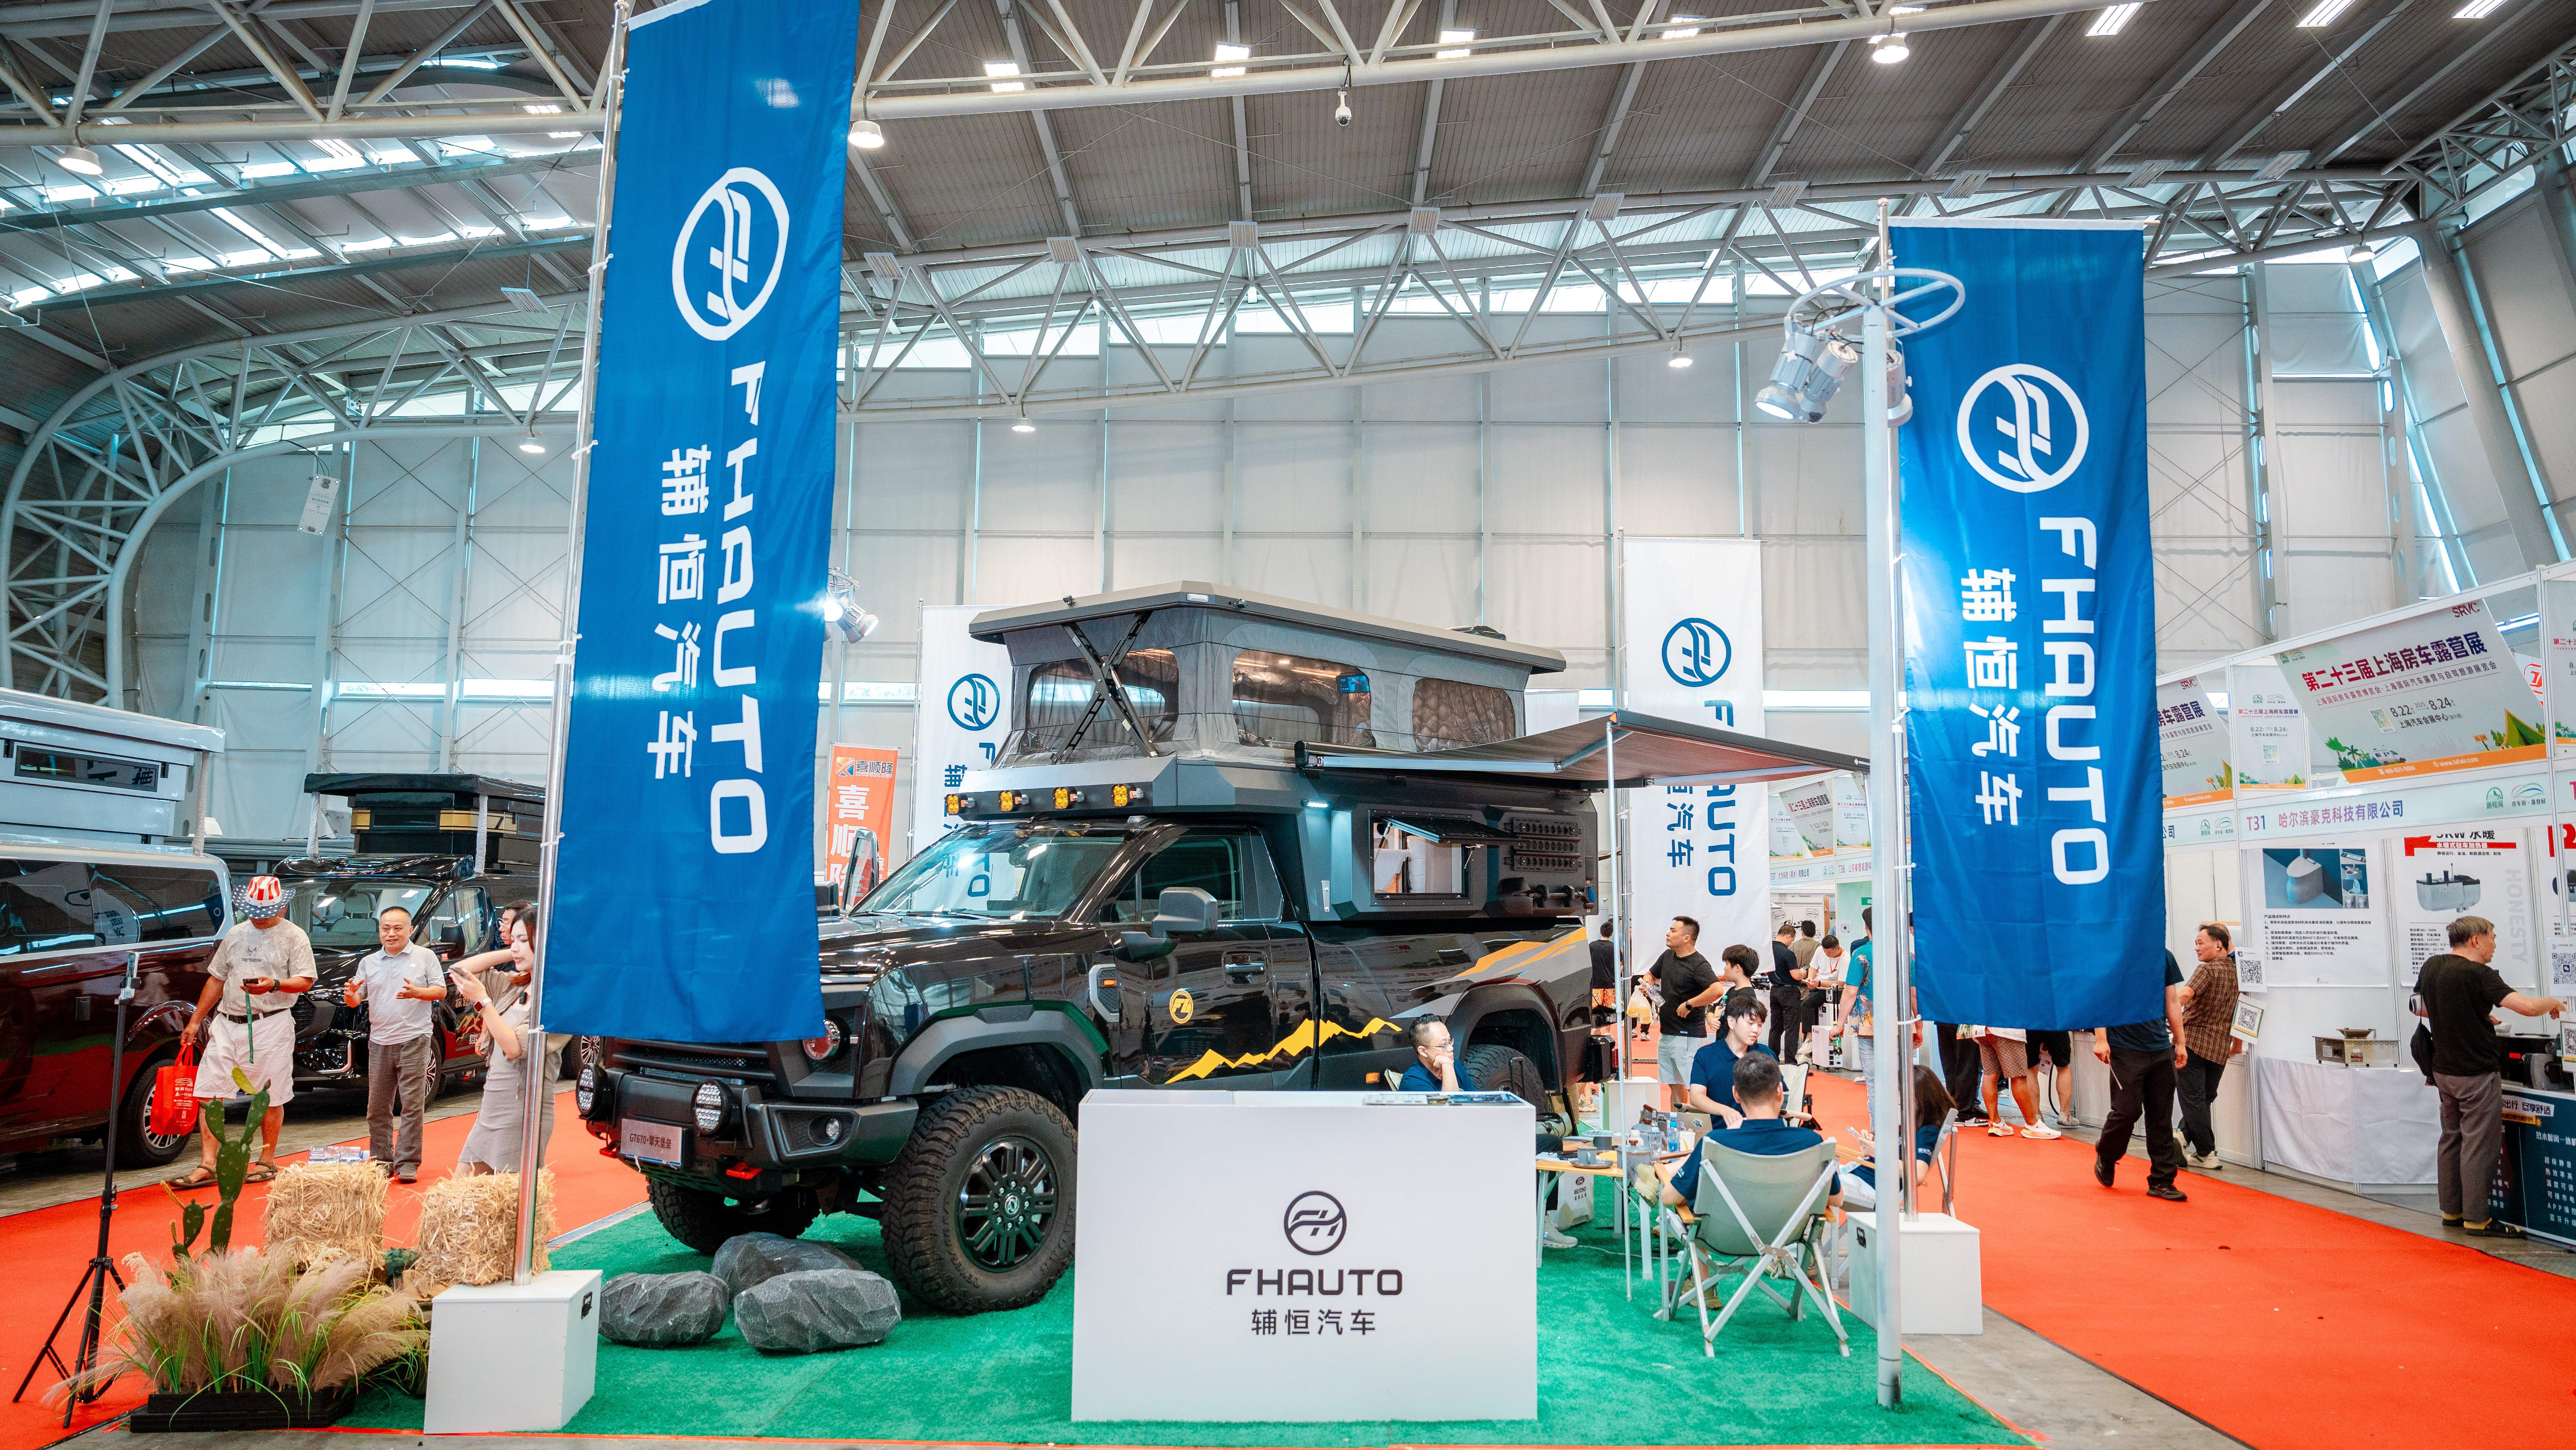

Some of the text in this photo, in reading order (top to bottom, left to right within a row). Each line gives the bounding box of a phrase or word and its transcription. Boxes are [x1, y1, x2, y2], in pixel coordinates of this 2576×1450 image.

[646, 444, 712, 781] 辅恒汽车
[711, 361, 766, 854] FHAUTO
[2302, 631, 2488, 692] 第二十三届上海房车露营展
[1961, 568, 2022, 825] 辅恒汽车
[2039, 517, 2110, 885] FHAUTO
[856, 760, 894, 774] 喜顺隆
[2279, 800, 2403, 828] 哈尔滨豪克科技有限公司
[2486, 800, 2504, 809] 路程网
[2247, 815, 2266, 831] T31
[2505, 869, 2528, 964] HONESTY
[2545, 1156, 2572, 1169] 超级静音
[2545, 1168, 2572, 1180] 热效率高
[1574, 1186, 1586, 1195] BEYOND
[2546, 1179, 2574, 1192] 温度可调
[2547, 1190, 2575, 1204] 可接市电
[1227, 1269, 1403, 1296] FHAUTO
[1251, 1308, 1376, 1336] 辅恒汽车
